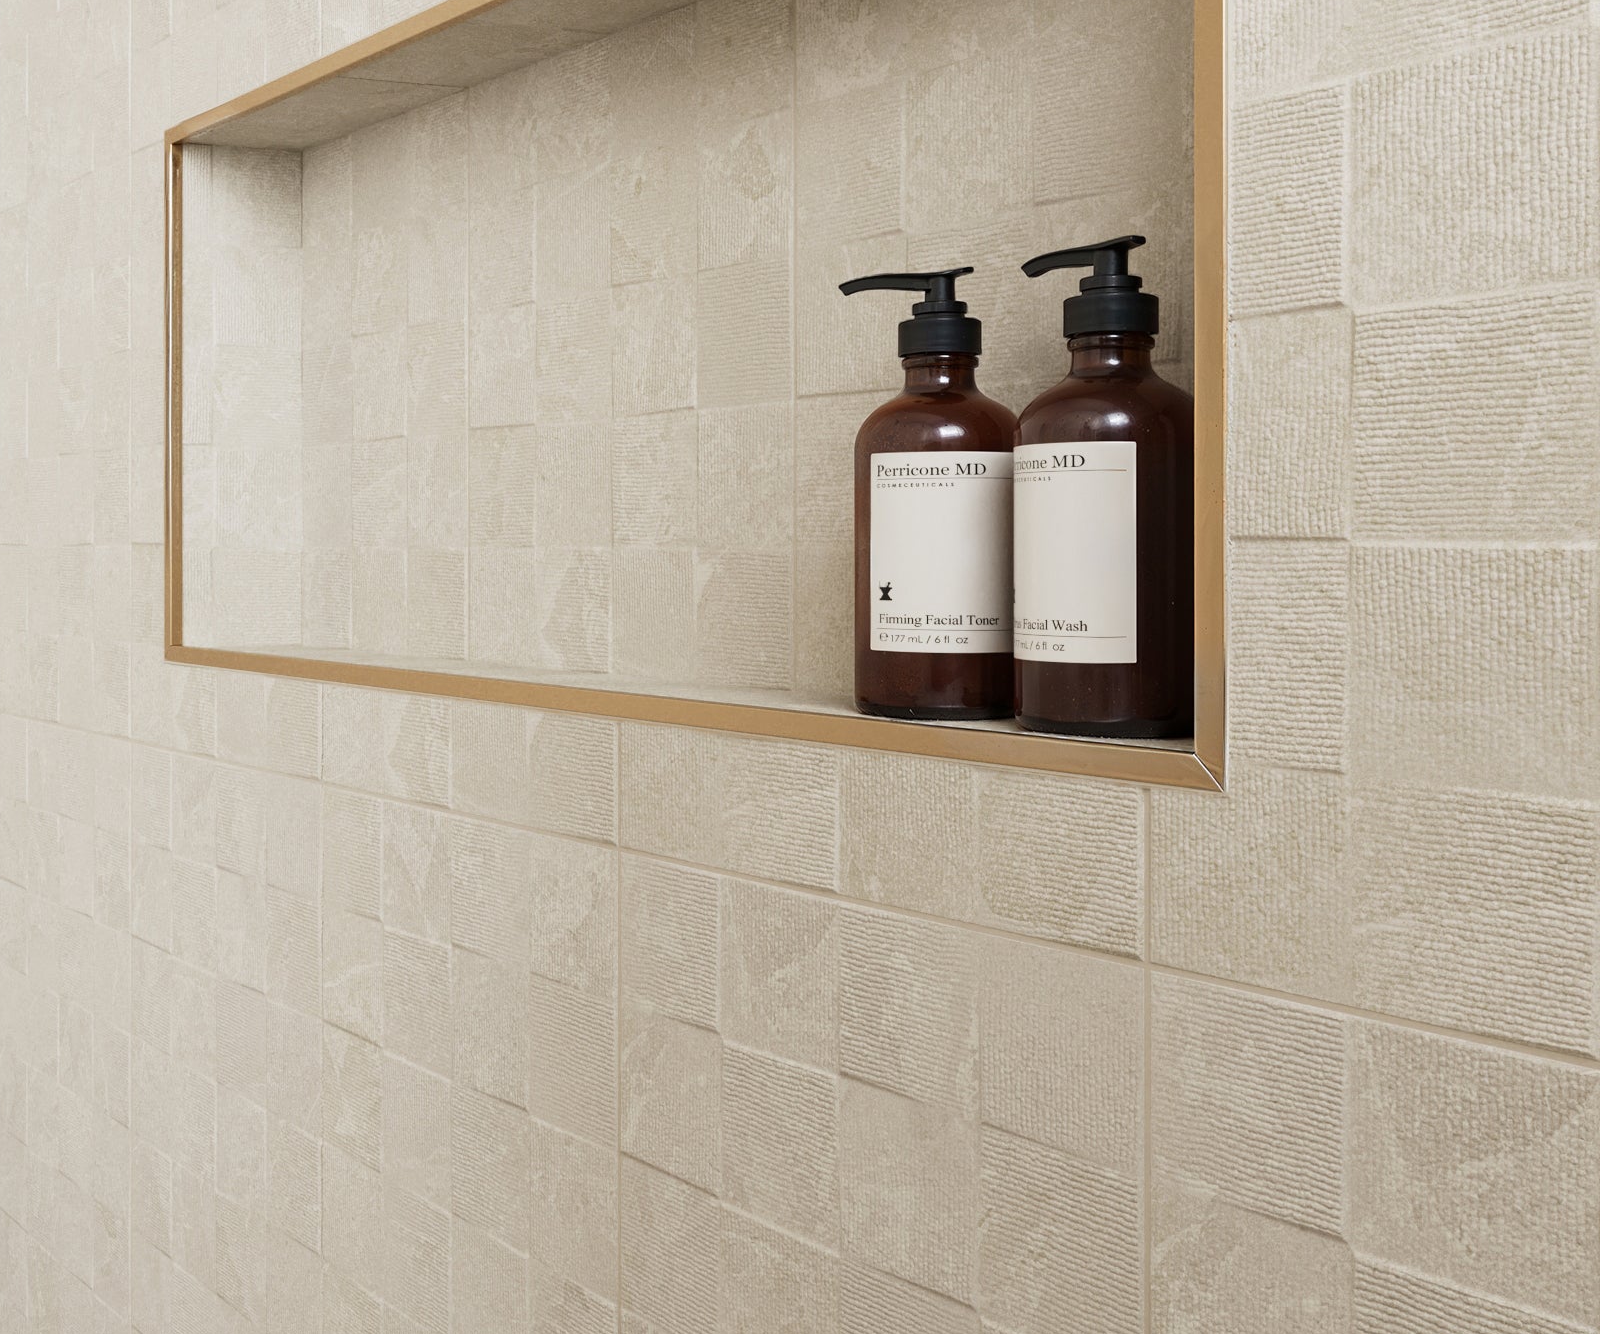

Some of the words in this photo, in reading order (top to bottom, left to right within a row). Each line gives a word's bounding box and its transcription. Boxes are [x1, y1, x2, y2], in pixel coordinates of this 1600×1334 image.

[1051, 454, 1086, 468] MD
[877, 463, 950, 477] Perricone
[955, 463, 987, 476] MD
[879, 613, 922, 627] Firming
[926, 614, 963, 626] Facial
[966, 614, 1000, 626] Toner
[1023, 618, 1048, 630] Facial
[1051, 619, 1088, 632] Wash
[934, 635, 941, 644] 6
[955, 636, 968, 644] oz
[1035, 641, 1041, 650] 6
[1052, 644, 1065, 652] oz
